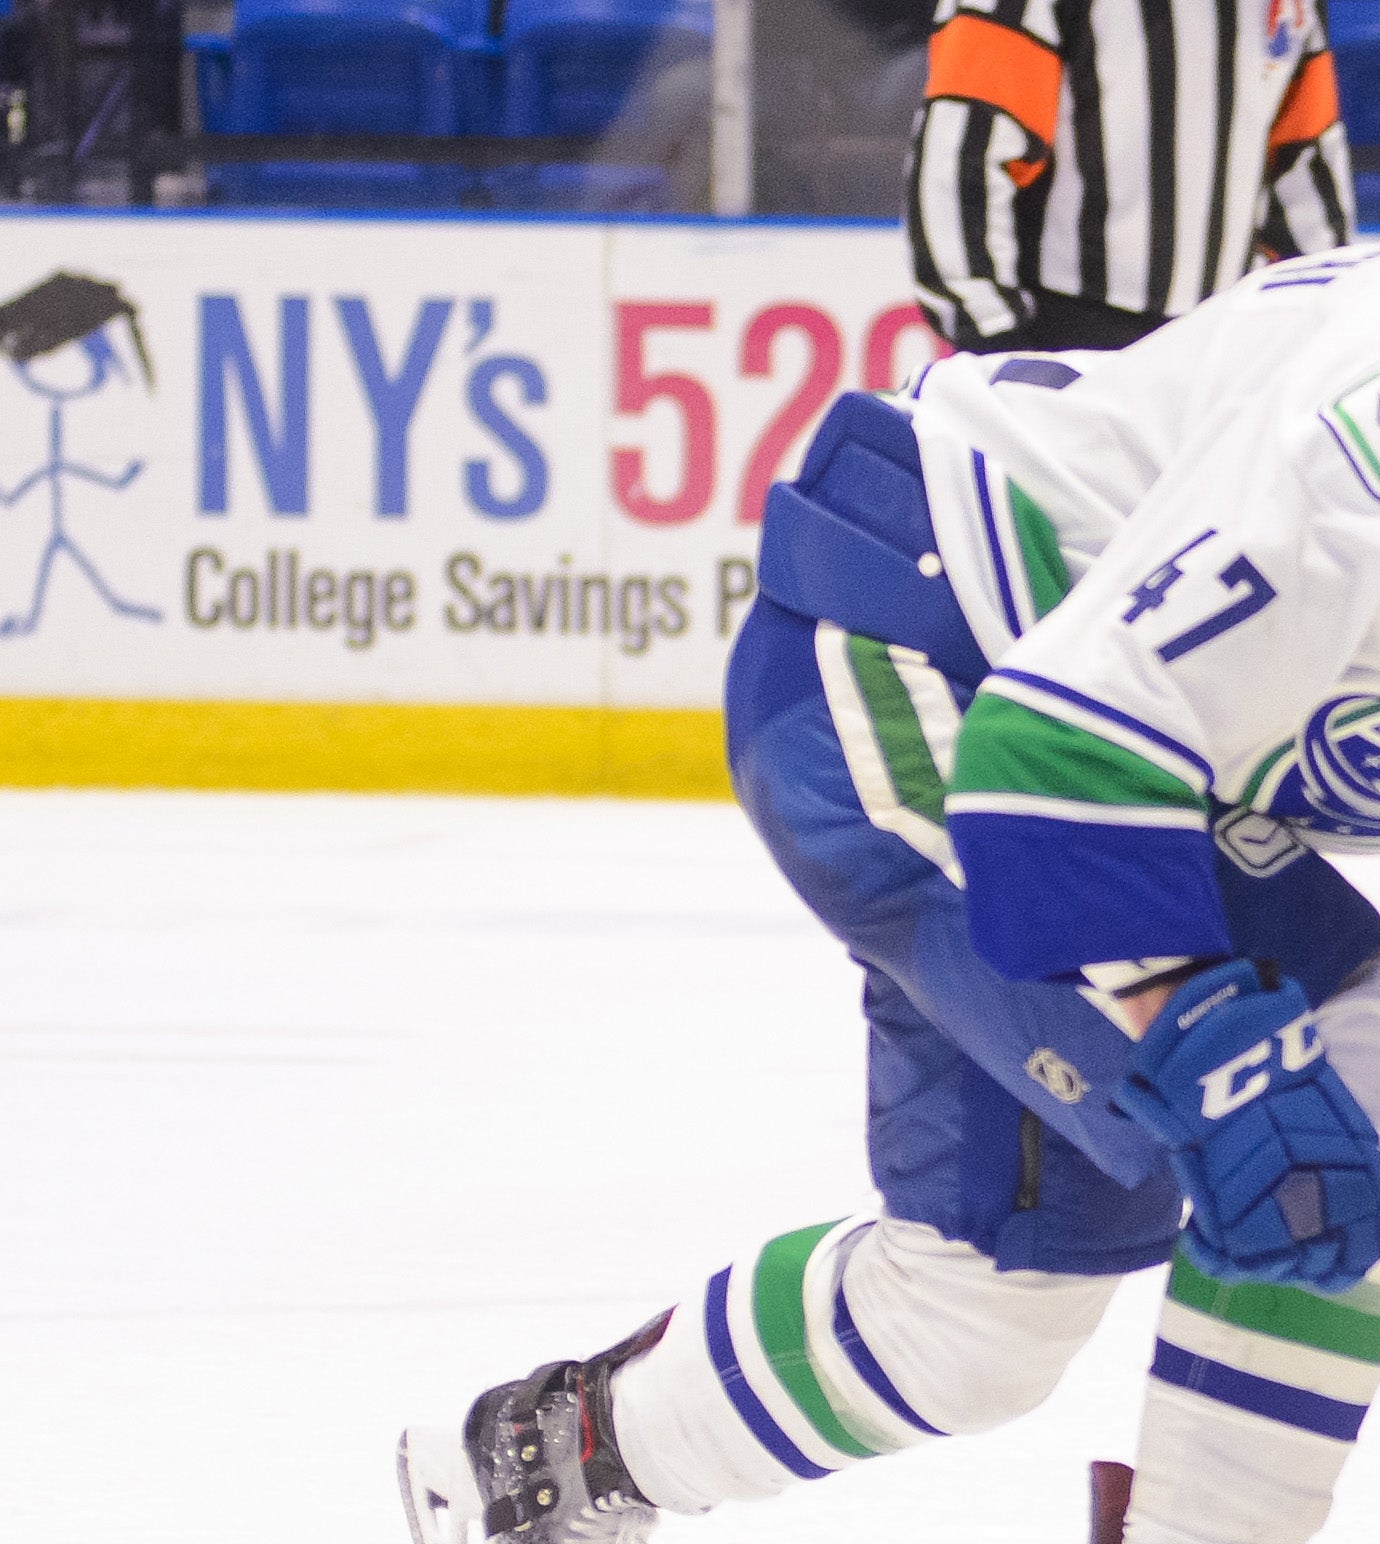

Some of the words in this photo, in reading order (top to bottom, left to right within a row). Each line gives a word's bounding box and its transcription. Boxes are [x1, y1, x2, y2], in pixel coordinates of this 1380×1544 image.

[198, 292, 551, 523] NY's
[184, 545, 417, 651] College
[442, 549, 690, 656] Savings
[1122, 528, 1278, 664] 47
